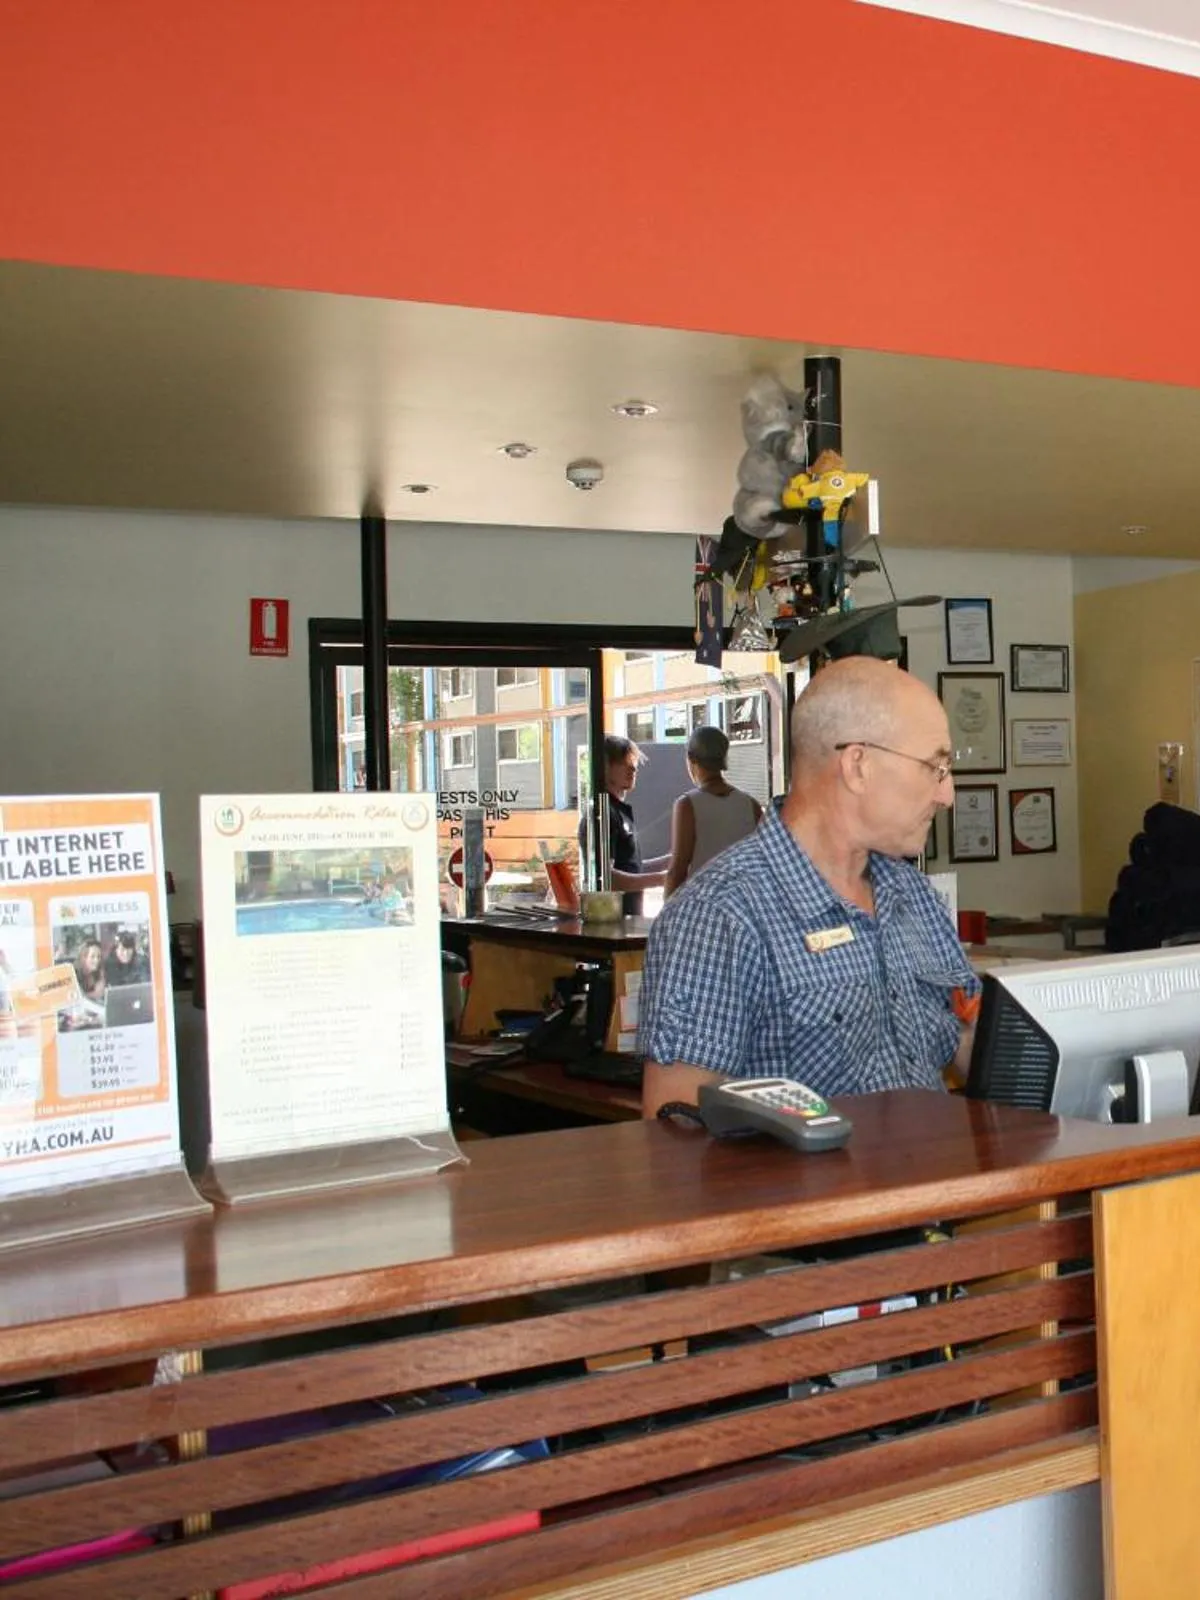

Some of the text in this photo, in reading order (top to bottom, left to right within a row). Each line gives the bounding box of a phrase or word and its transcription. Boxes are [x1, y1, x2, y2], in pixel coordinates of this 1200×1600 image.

[436, 790, 519, 804] ESTS ONLY
[436, 808, 510, 822] PAS HIS
[17, 831, 123, 856] INTERNET
[88, 852, 146, 874] HERE
[80, 901, 139, 915] WIRELESS
